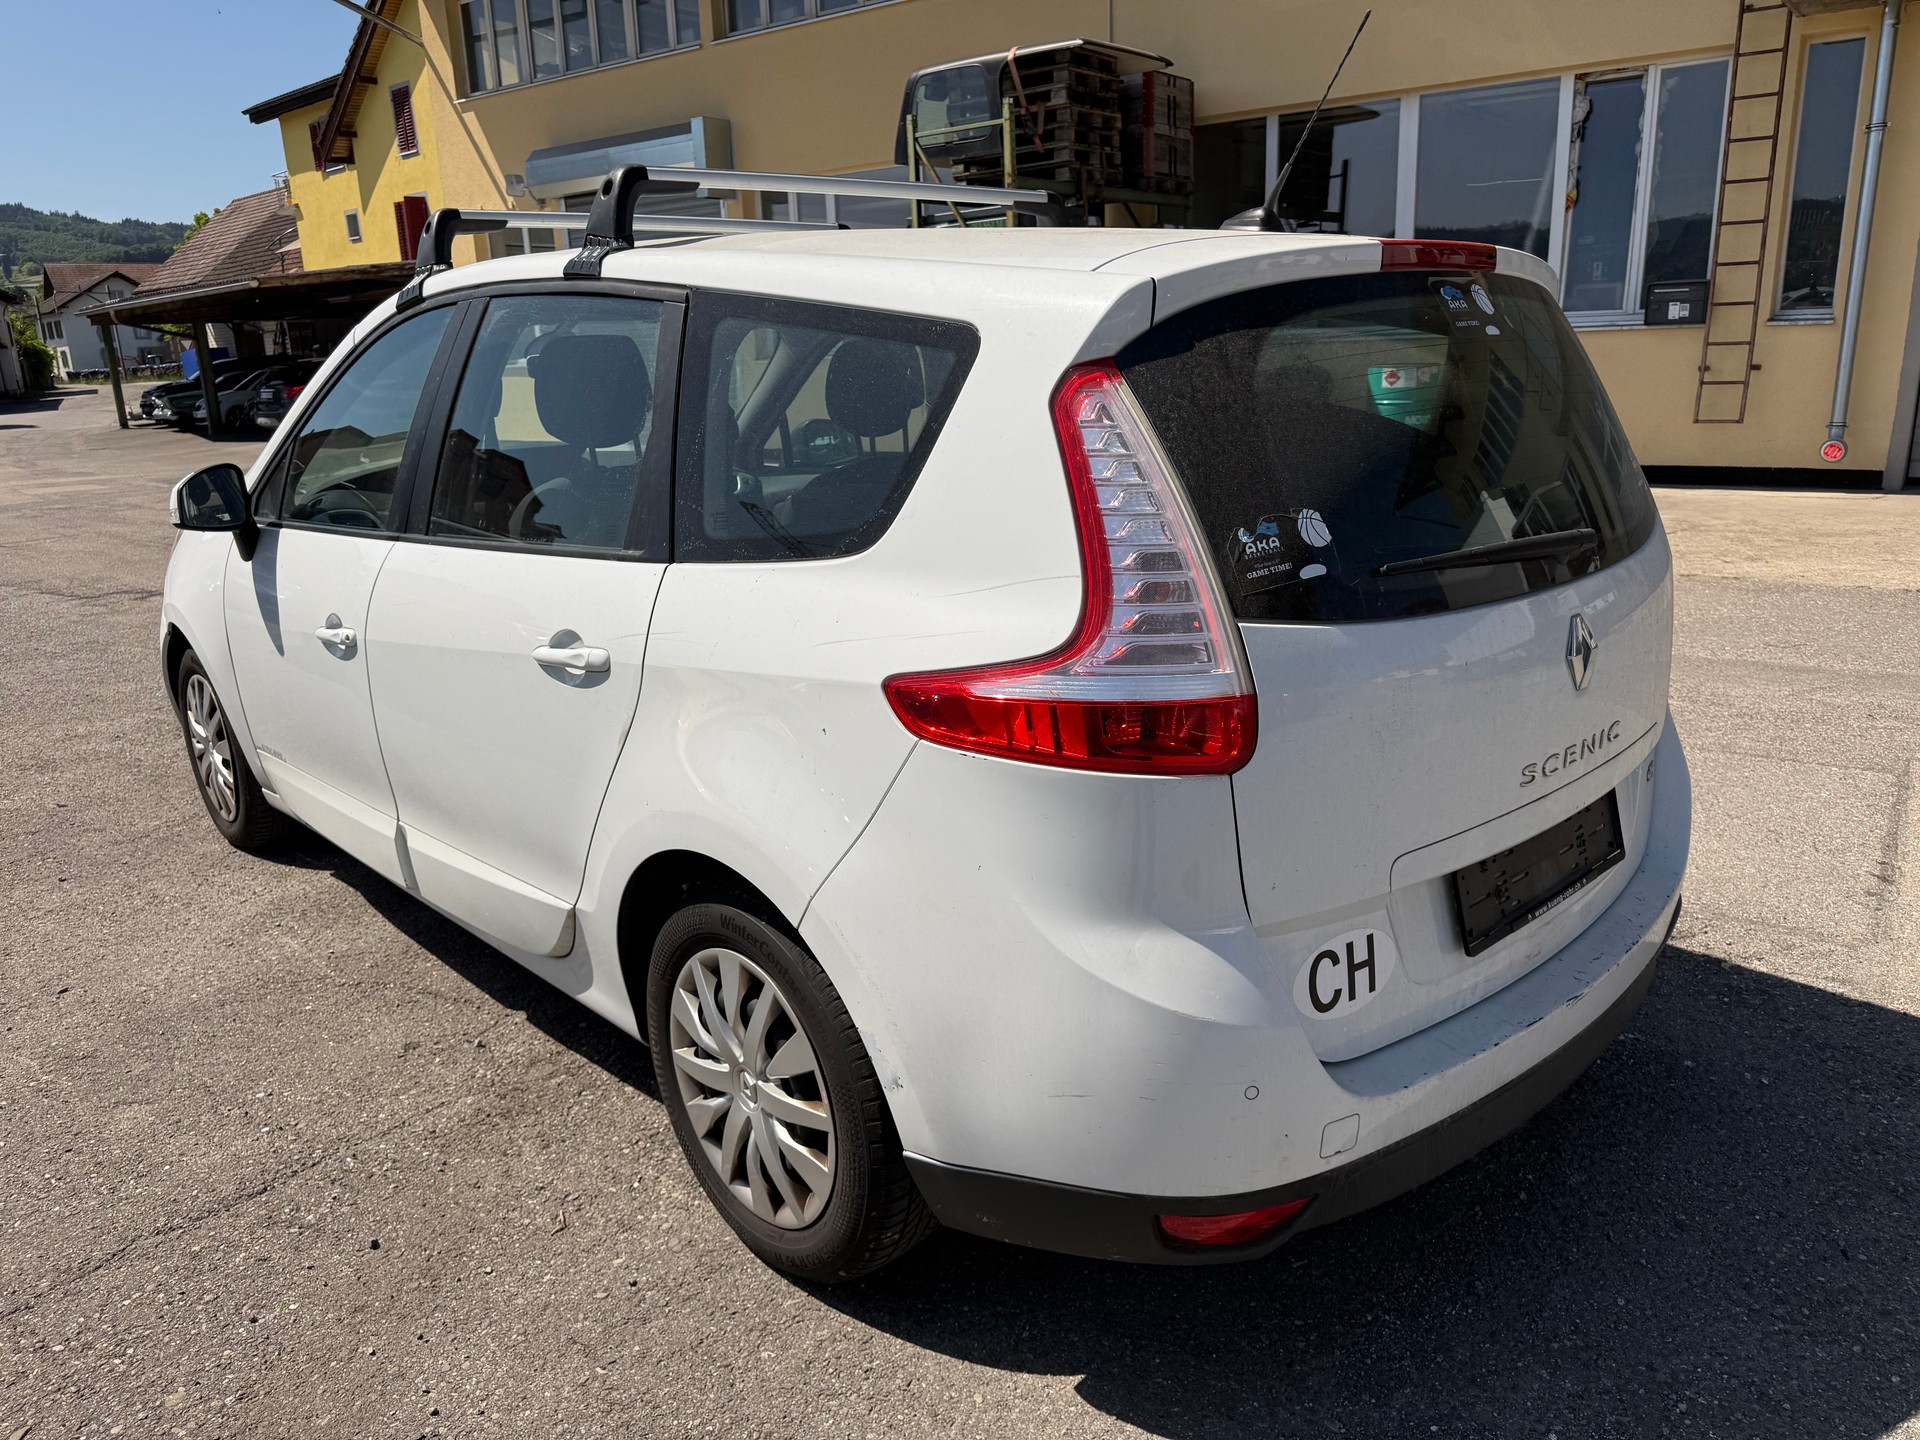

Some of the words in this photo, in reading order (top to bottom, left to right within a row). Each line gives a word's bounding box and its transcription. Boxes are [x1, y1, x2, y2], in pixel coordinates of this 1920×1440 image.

[1448, 299, 1469, 309] AKA
[1245, 536, 1281, 555] AKA
[1246, 568, 1270, 579] GAME
[1269, 561, 1293, 573] TIME!
[1520, 720, 1622, 788] SCENIC
[720, 912, 807, 1003] WinterContact
[1308, 932, 1376, 1013] CH
